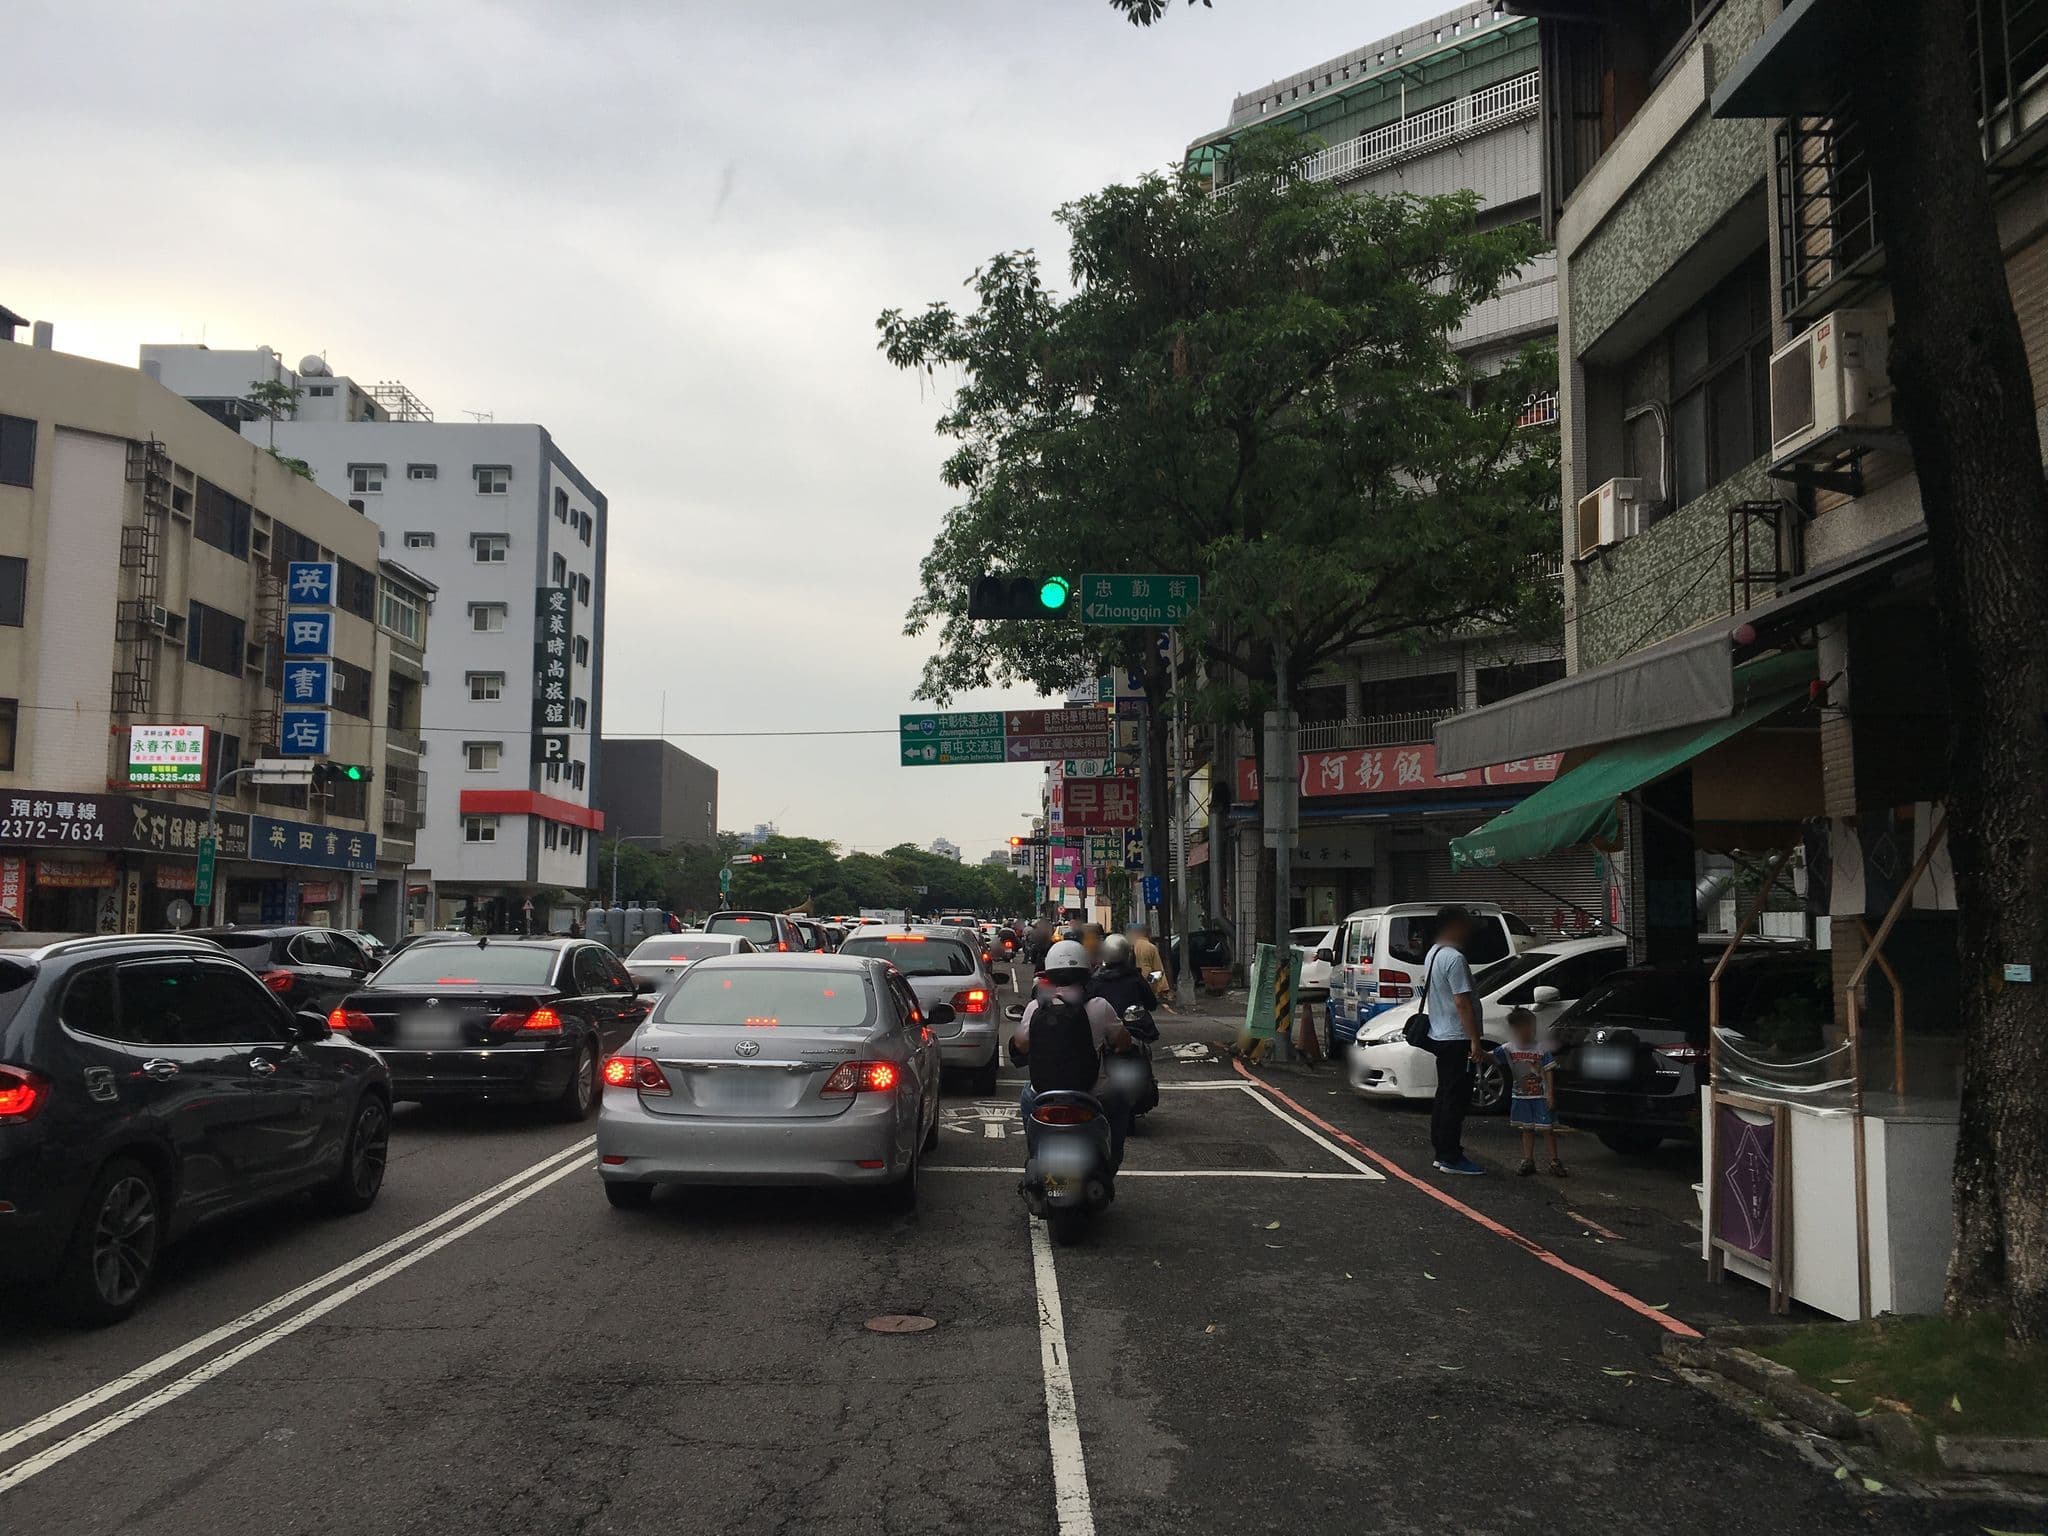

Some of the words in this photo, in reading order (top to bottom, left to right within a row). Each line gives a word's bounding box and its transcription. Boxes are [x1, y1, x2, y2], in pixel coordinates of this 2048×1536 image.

[1095, 579, 1187, 599] 忠勤街
[1095, 602, 1161, 621] Zhongqin
[1166, 603, 1182, 618] St
[287, 568, 328, 748] 英田書店
[938, 713, 999, 729] 中彰快速公路
[132, 739, 200, 753] 永春不動產
[545, 738, 561, 758] P
[940, 739, 1002, 754] 南屯交流道
[129, 773, 201, 782] 0988-325-428
[1320, 751, 1466, 791] 阿彰飯
[10, 798, 97, 820] 預約專線
[1068, 783, 1134, 822] 早點
[1, 820, 104, 842] 2372-7634
[269, 825, 362, 858] 英田書店
[1093, 838, 1121, 848] 消化
